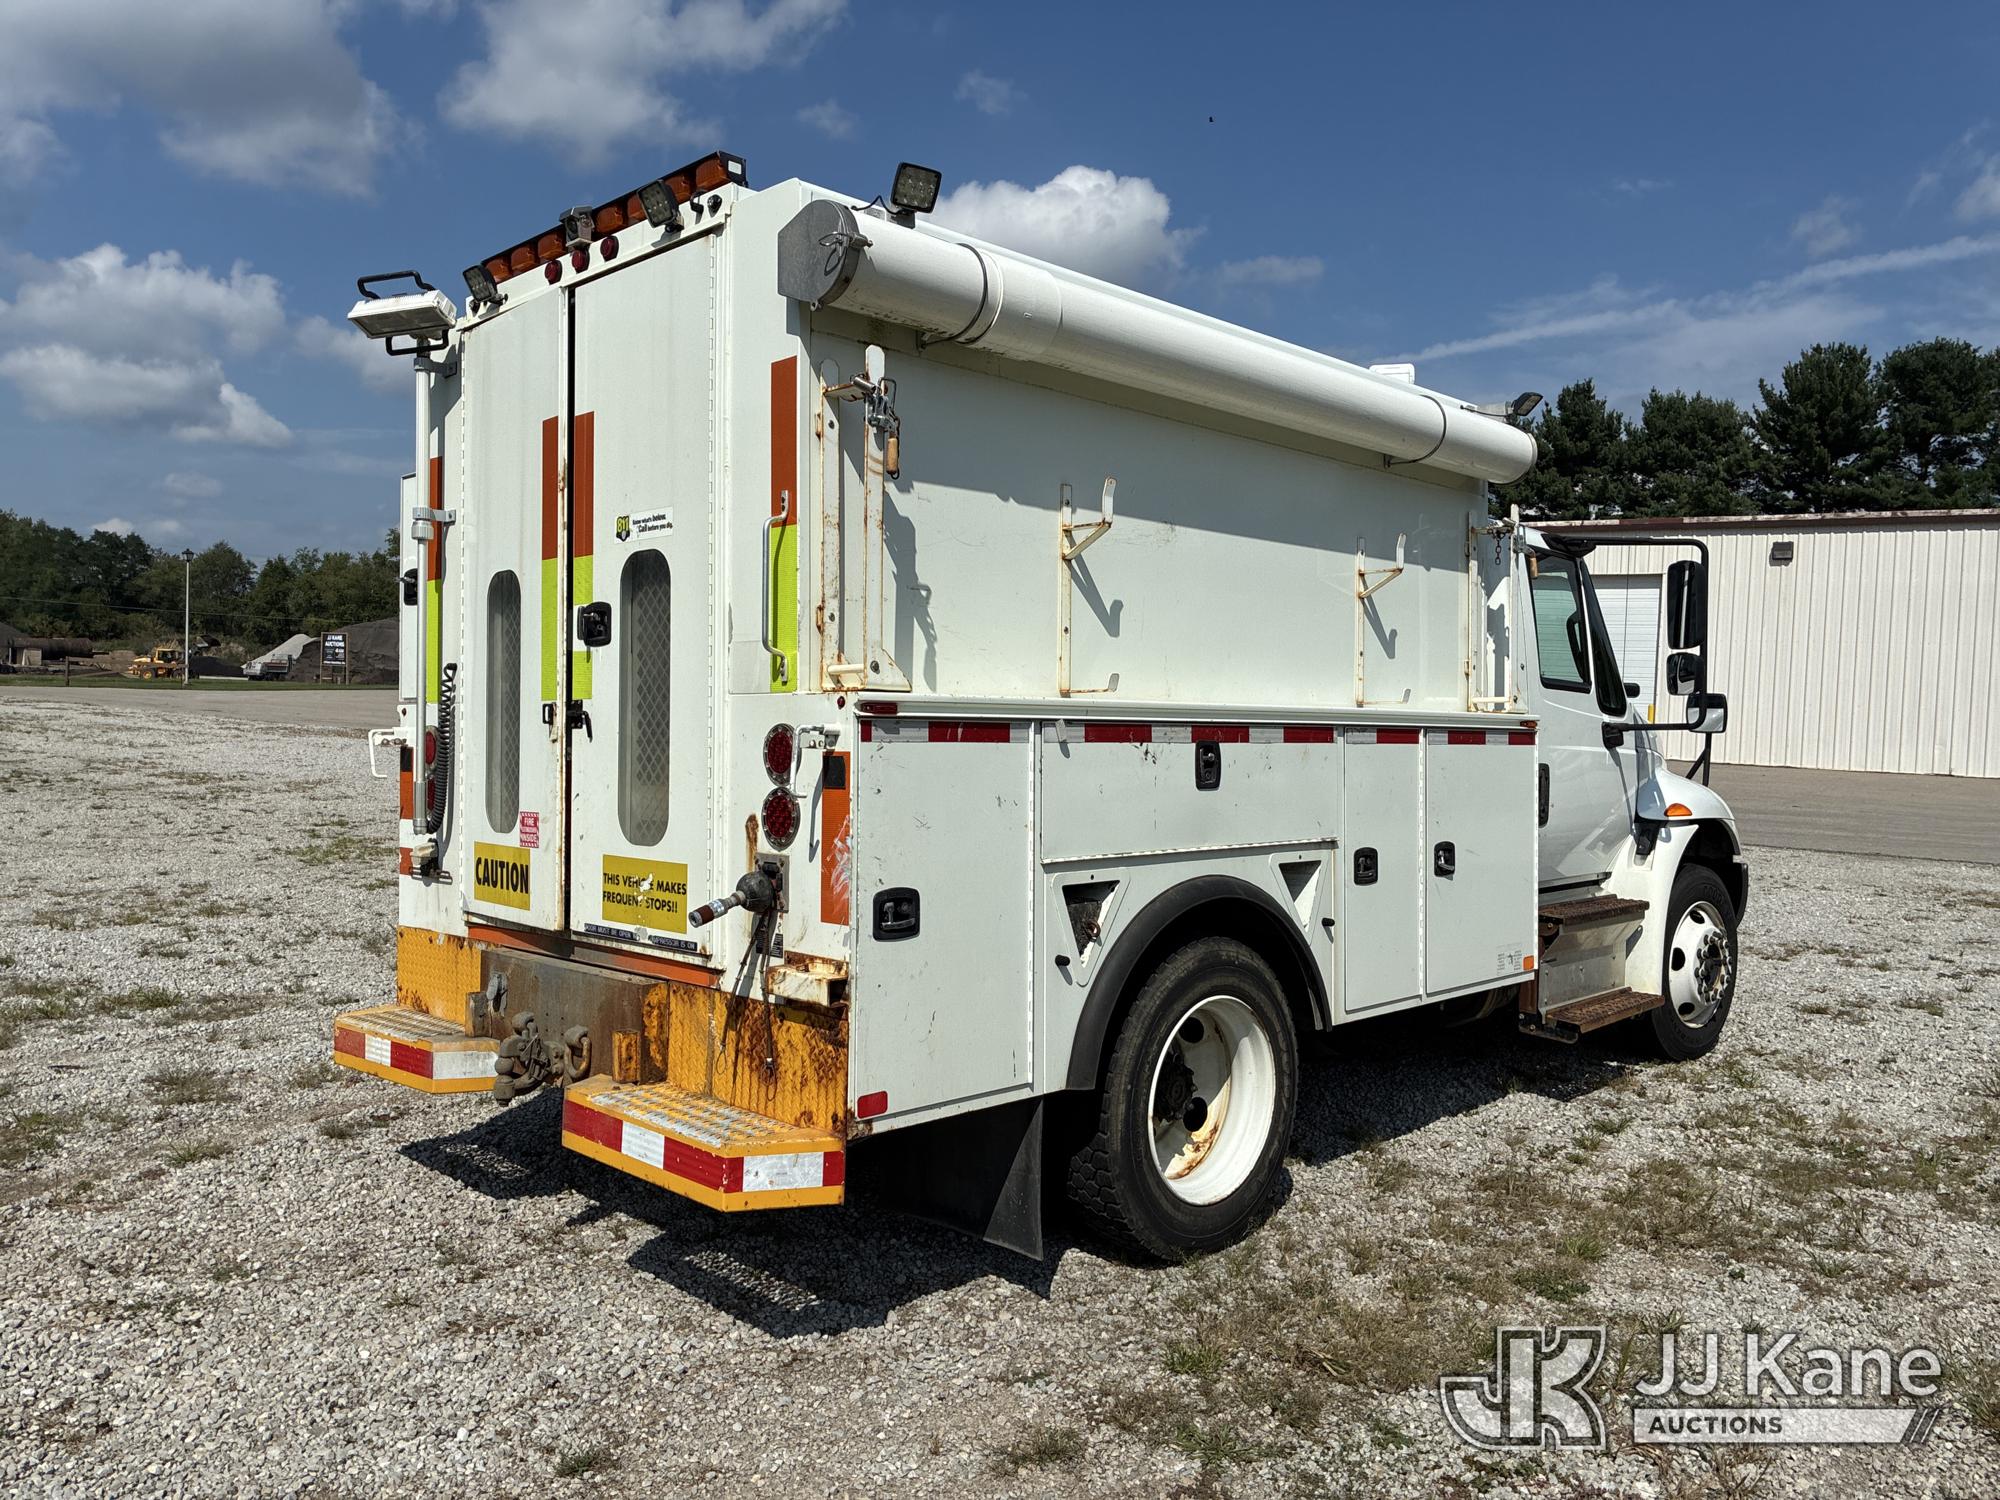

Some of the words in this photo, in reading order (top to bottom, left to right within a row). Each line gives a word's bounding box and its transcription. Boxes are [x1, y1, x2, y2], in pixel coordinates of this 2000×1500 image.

[616, 516, 629, 532] 811
[638, 523, 647, 532] Call
[524, 817, 535, 826] FIRE
[475, 856, 529, 894] CAUTION
[603, 873, 620, 886] THIS
[621, 875, 654, 890] VEHIE
[656, 880, 687, 896] MAKES
[645, 896, 678, 913] STOPS!!
